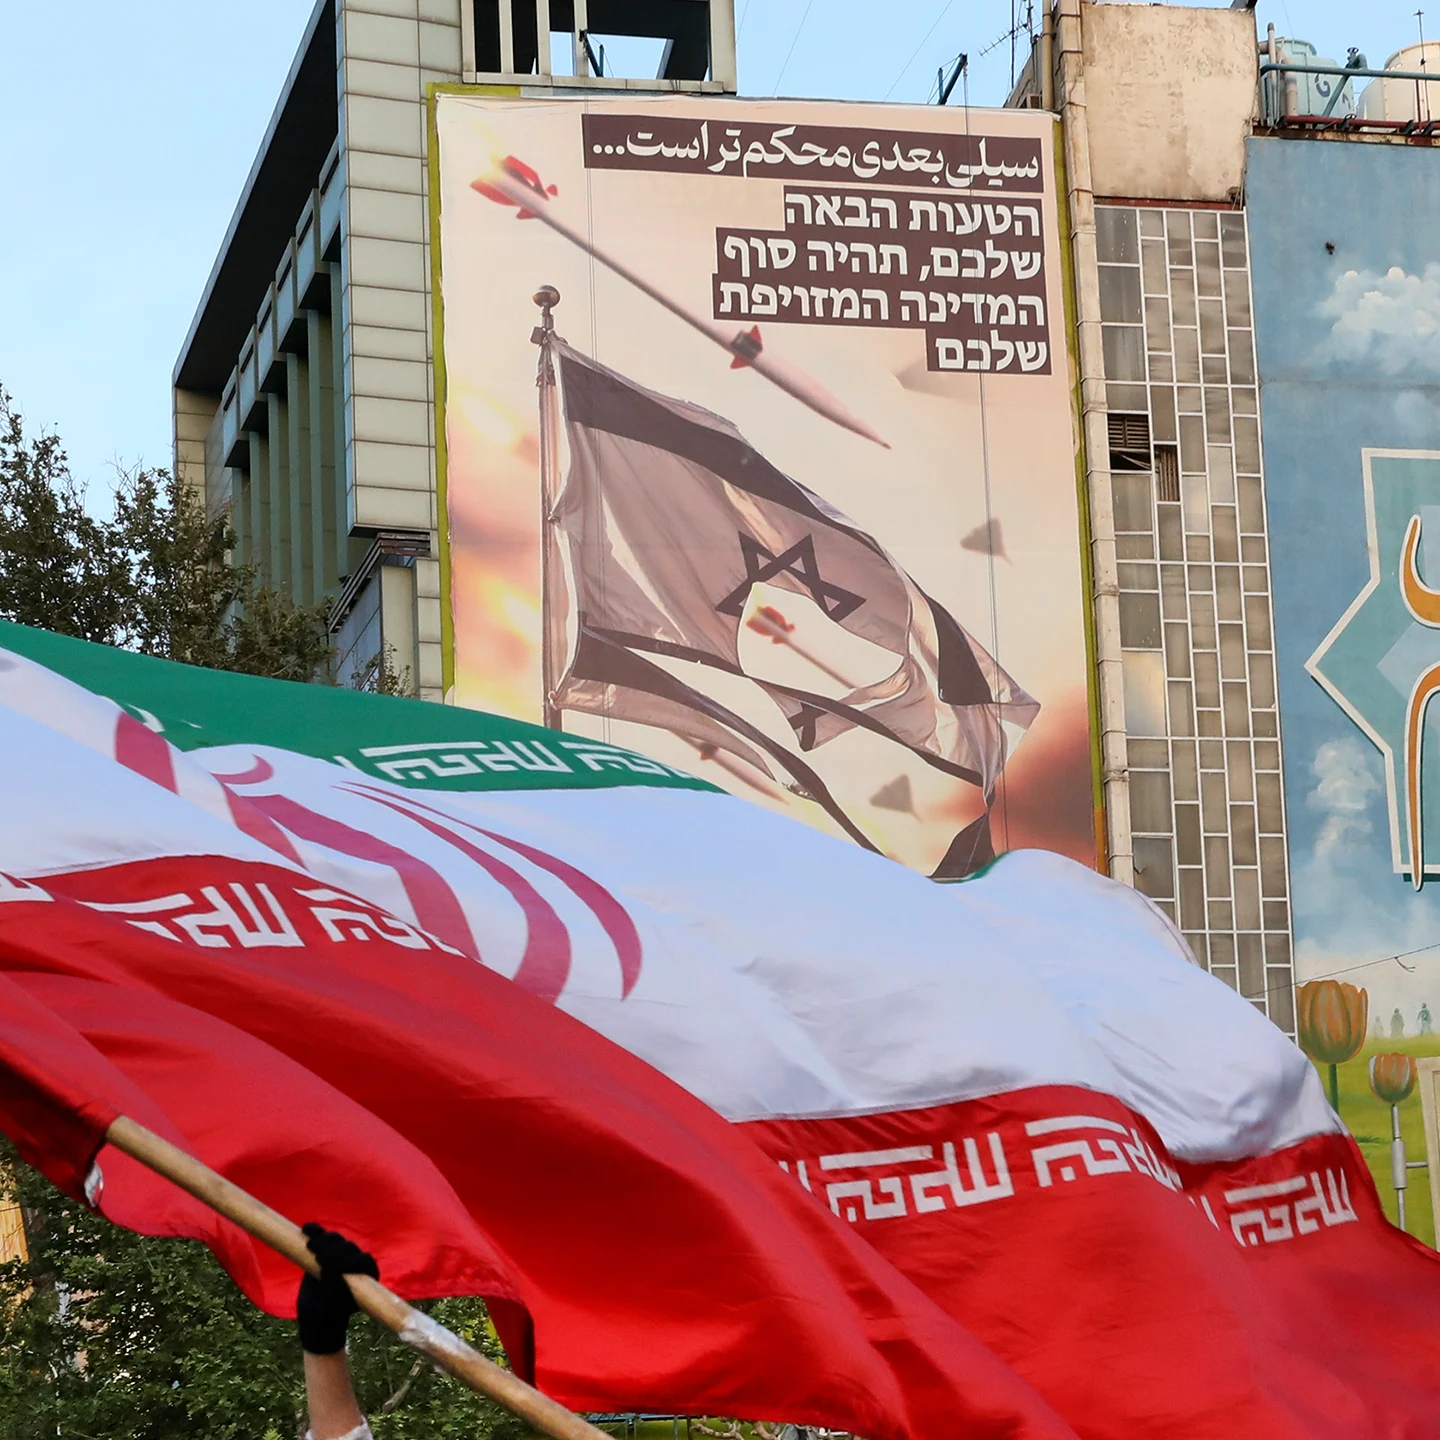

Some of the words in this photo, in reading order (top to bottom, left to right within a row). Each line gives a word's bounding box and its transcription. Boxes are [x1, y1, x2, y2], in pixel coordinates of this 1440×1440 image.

[851, 142, 944, 184] بعدی
[787, 193, 898, 229] הבאה
[909, 201, 1040, 238] הטעות
[723, 236, 797, 278] סוף
[806, 241, 908, 275] תהיה
[919, 240, 1042, 282] שלכם,
[719, 284, 889, 320] המזויפת
[899, 291, 1045, 326] המדינה
[935, 329, 1047, 372] שלכם
[469, 740, 575, 773] الله
[171, 882, 306, 949] الله
[909, 1131, 1015, 1214] الله
